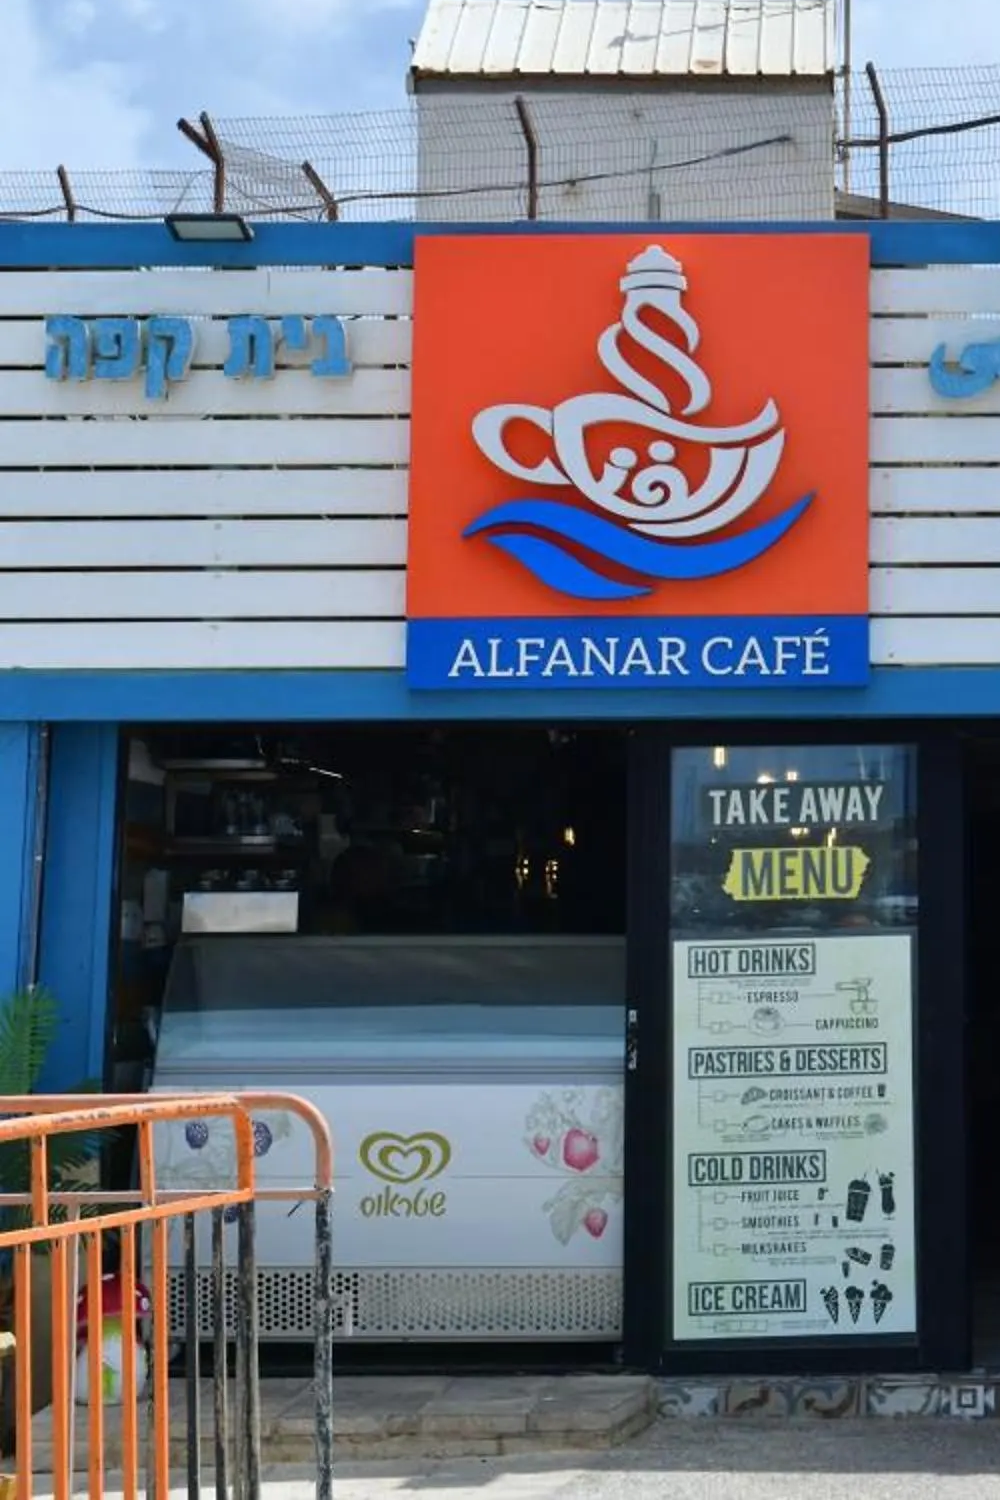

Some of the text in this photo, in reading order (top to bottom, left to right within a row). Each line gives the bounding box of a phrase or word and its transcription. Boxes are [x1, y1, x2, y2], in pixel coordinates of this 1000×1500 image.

[45, 314, 353, 399] בית קפה
[447, 627, 830, 678] ALFANAR CAFÉ
[708, 785, 884, 826] TAKE AWAY
[740, 848, 854, 897] MENU
[694, 947, 810, 973] HOT DRINKS
[747, 990, 799, 1003] ESPRESSO
[815, 1017, 879, 1031] CAPPUCCINO
[694, 1047, 881, 1075] PASTRIES & DESSERTS
[769, 1087, 824, 1101] CROISSANT
[837, 1085, 873, 1100] COFFEE
[771, 1116, 804, 1130] CAKES
[815, 1115, 861, 1129] WAFFLES
[694, 1155, 820, 1182] COLD DRINKS
[361, 1185, 447, 1218] שטראוס
[741, 1189, 800, 1203] FRUIT JUICE
[741, 1214, 800, 1230] SMOOTHIES
[741, 1242, 807, 1255] MILKSHAKES
[694, 1283, 802, 1312] ICE CREAM
